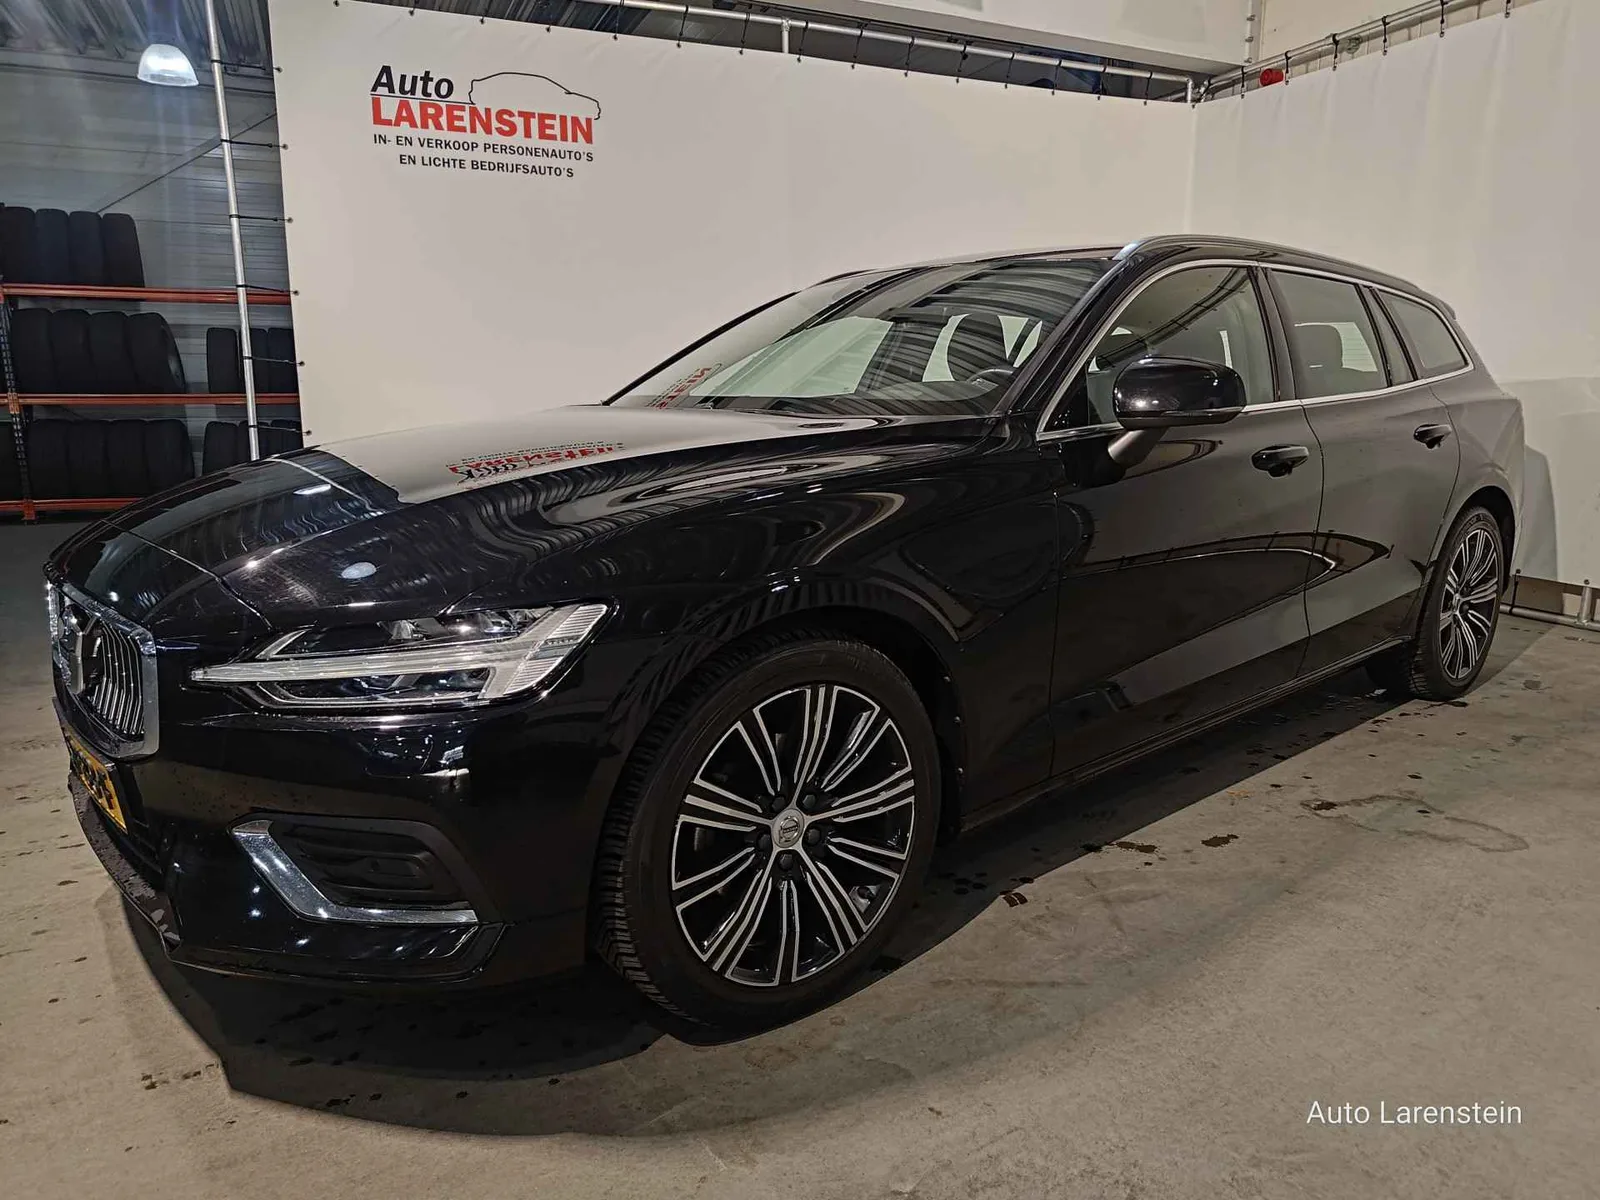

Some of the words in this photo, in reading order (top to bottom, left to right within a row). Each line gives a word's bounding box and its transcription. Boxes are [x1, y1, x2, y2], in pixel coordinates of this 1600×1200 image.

[371, 65, 454, 99] Auto
[371, 97, 593, 144] LARENSTEIN
[373, 134, 391, 145] IN-
[396, 135, 413, 147] EN
[418, 137, 479, 152] VERKOOP
[483, 142, 594, 162] PERSONENAUTO'S
[399, 154, 417, 166] EN
[421, 156, 466, 169] LICHTE
[471, 160, 574, 178] BEDRIJFSAUTO'S
